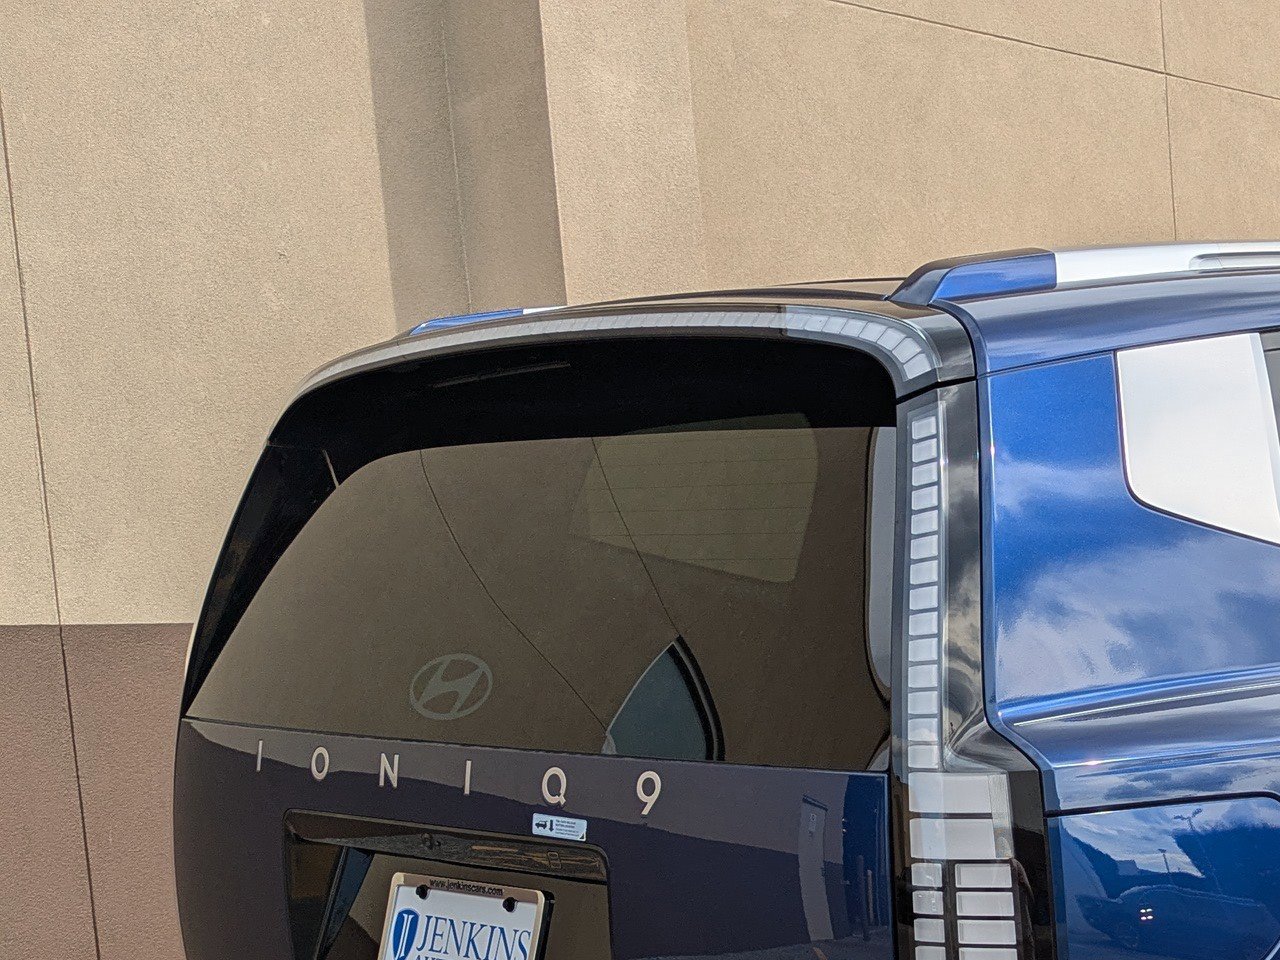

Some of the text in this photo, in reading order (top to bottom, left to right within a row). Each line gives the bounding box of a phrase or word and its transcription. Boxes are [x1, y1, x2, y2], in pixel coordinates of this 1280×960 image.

[257, 740, 662, 815] IONIQ 9
[429, 879, 504, 896] www.jenkinscars.com
